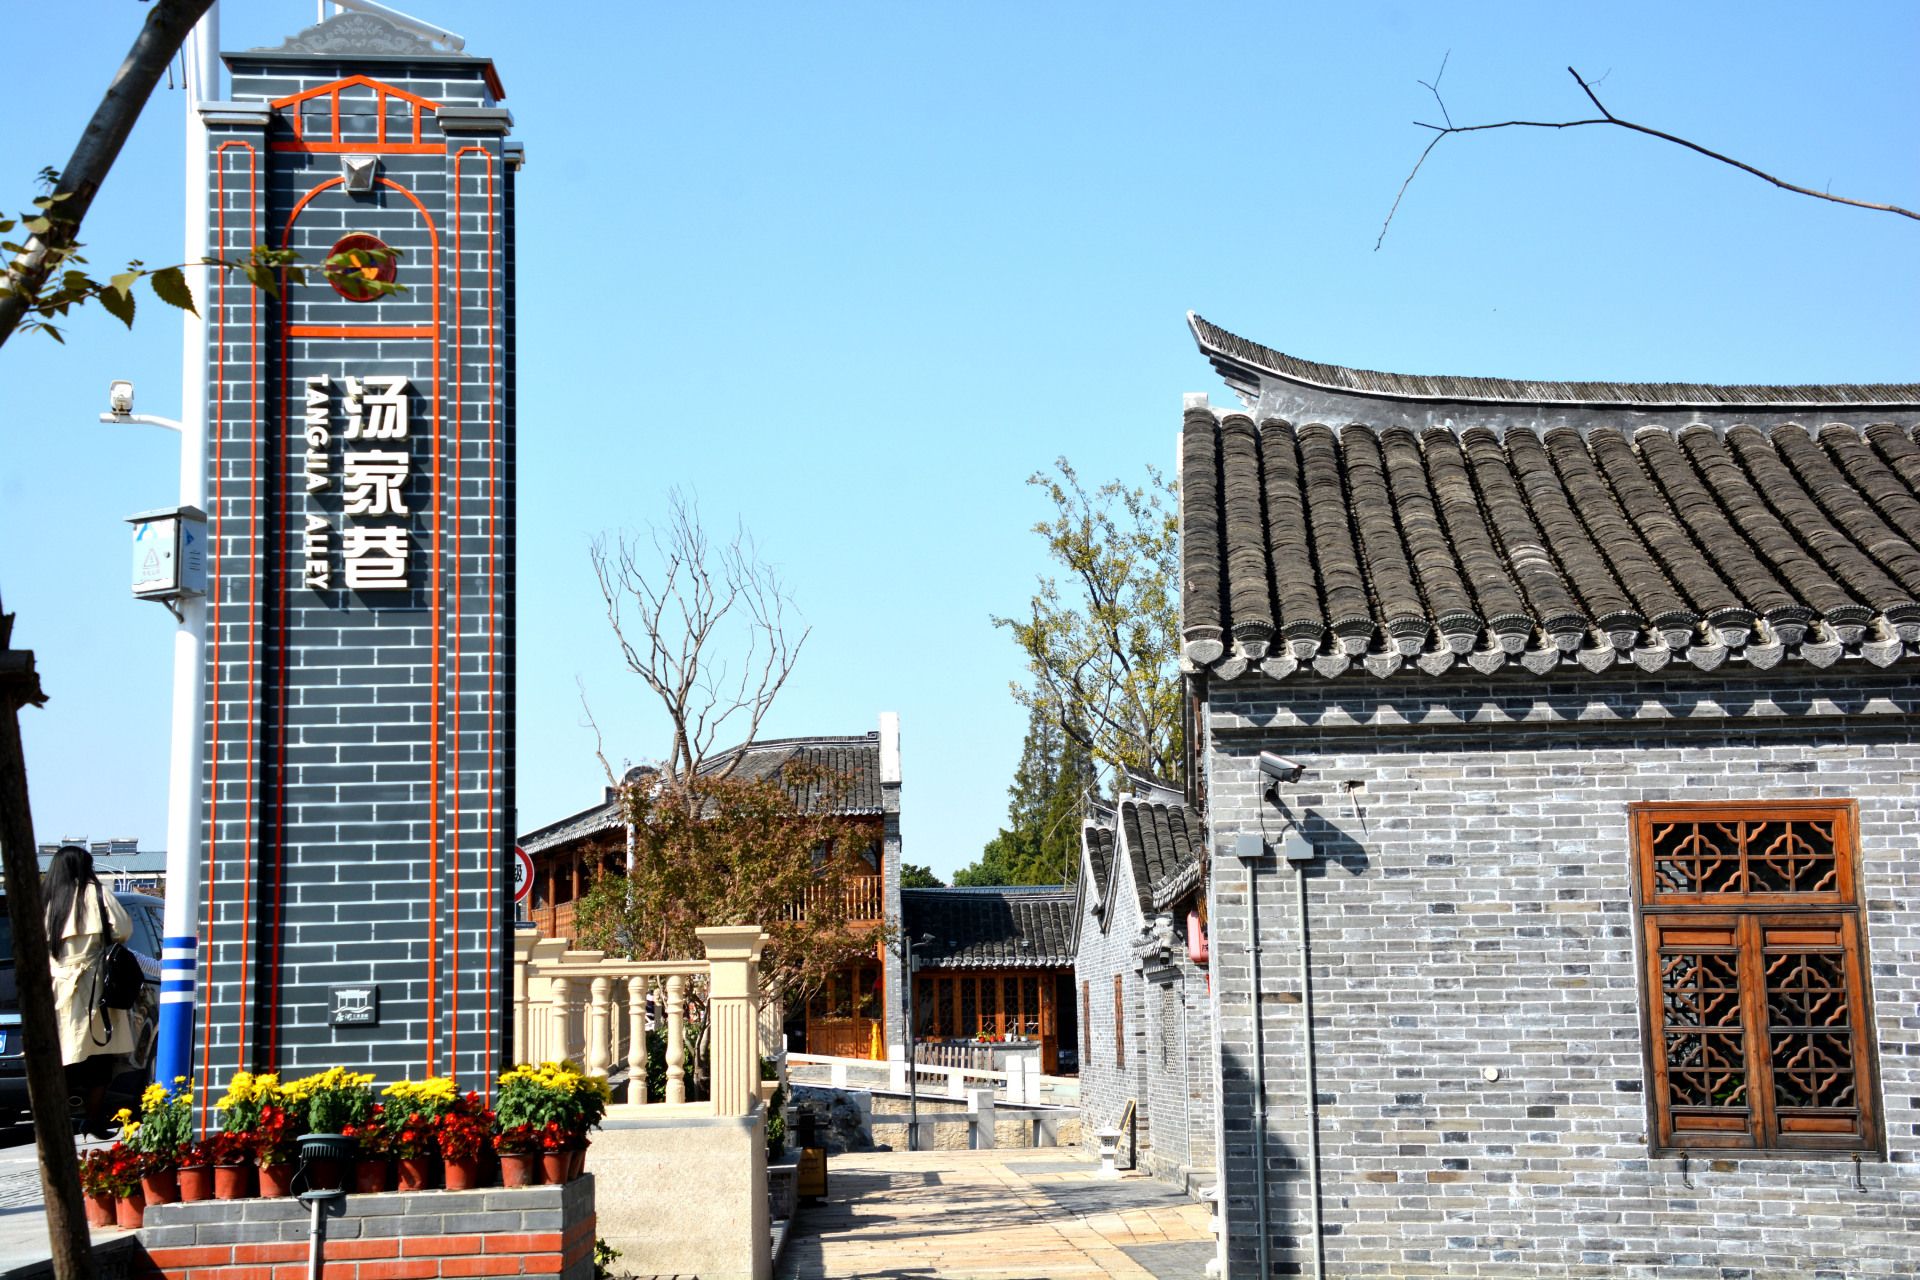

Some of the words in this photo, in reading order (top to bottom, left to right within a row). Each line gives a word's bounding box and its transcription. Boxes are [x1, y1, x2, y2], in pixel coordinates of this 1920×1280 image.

[306, 374, 330, 493] TANGJIA
[343, 375, 410, 590] 汤家巷
[305, 514, 330, 590] ALLEY
